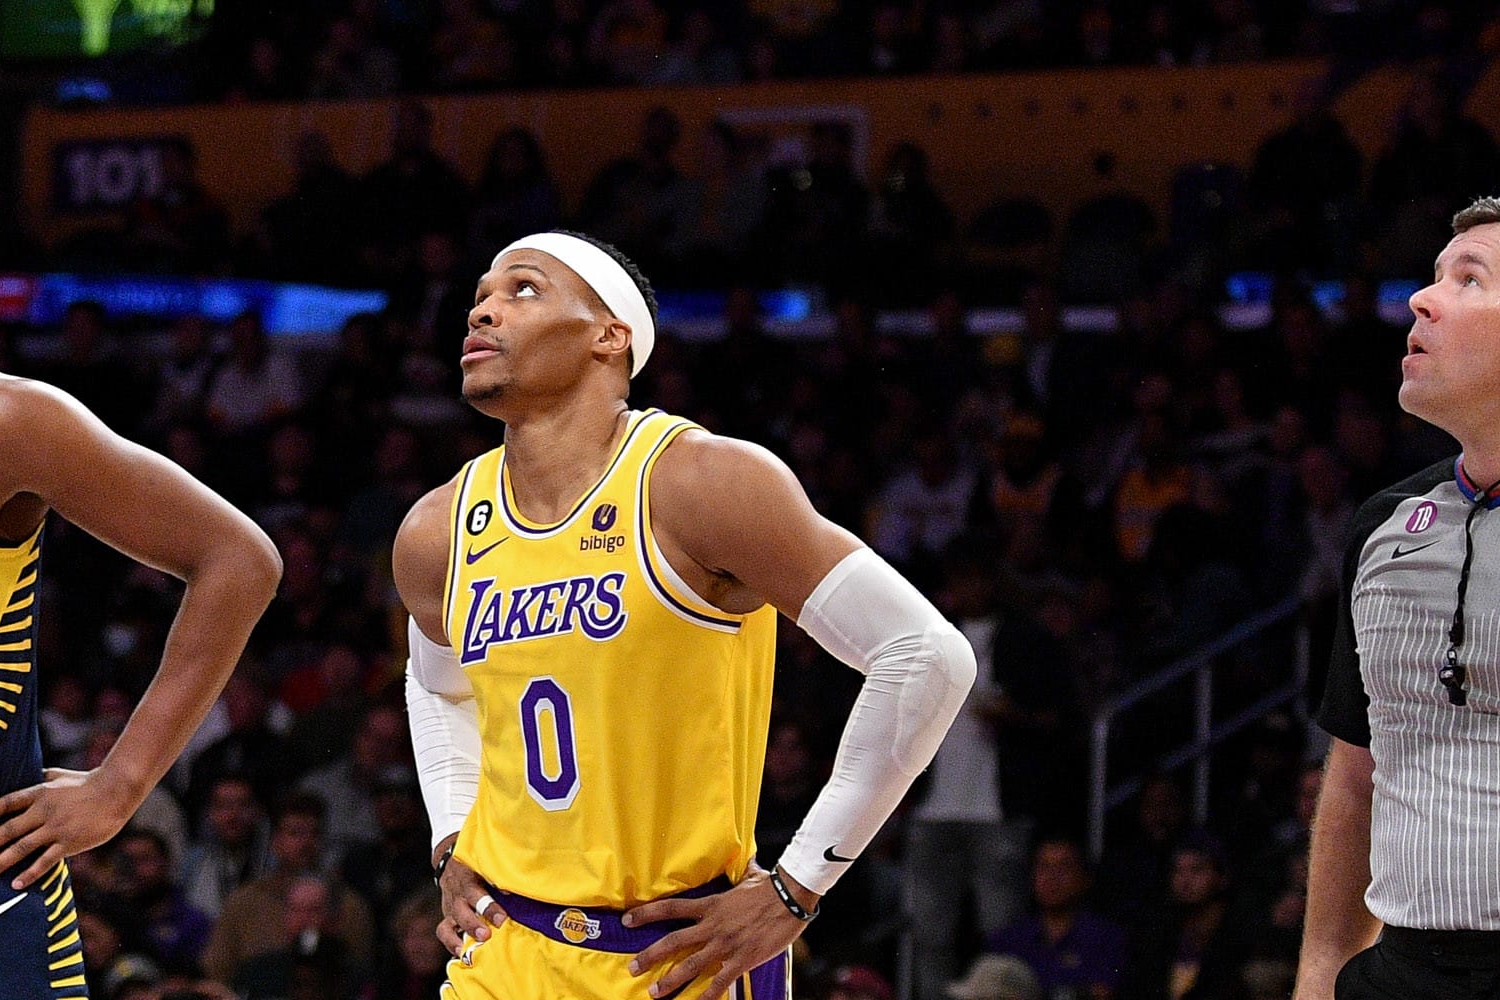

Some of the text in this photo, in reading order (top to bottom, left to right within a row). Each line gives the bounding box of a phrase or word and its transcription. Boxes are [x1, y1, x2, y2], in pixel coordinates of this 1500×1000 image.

[471, 503, 490, 533] 6
[1410, 505, 1433, 532] TB
[580, 534, 626, 553] bibigo
[459, 572, 629, 666] LAKERS
[519, 674, 582, 812] 0
